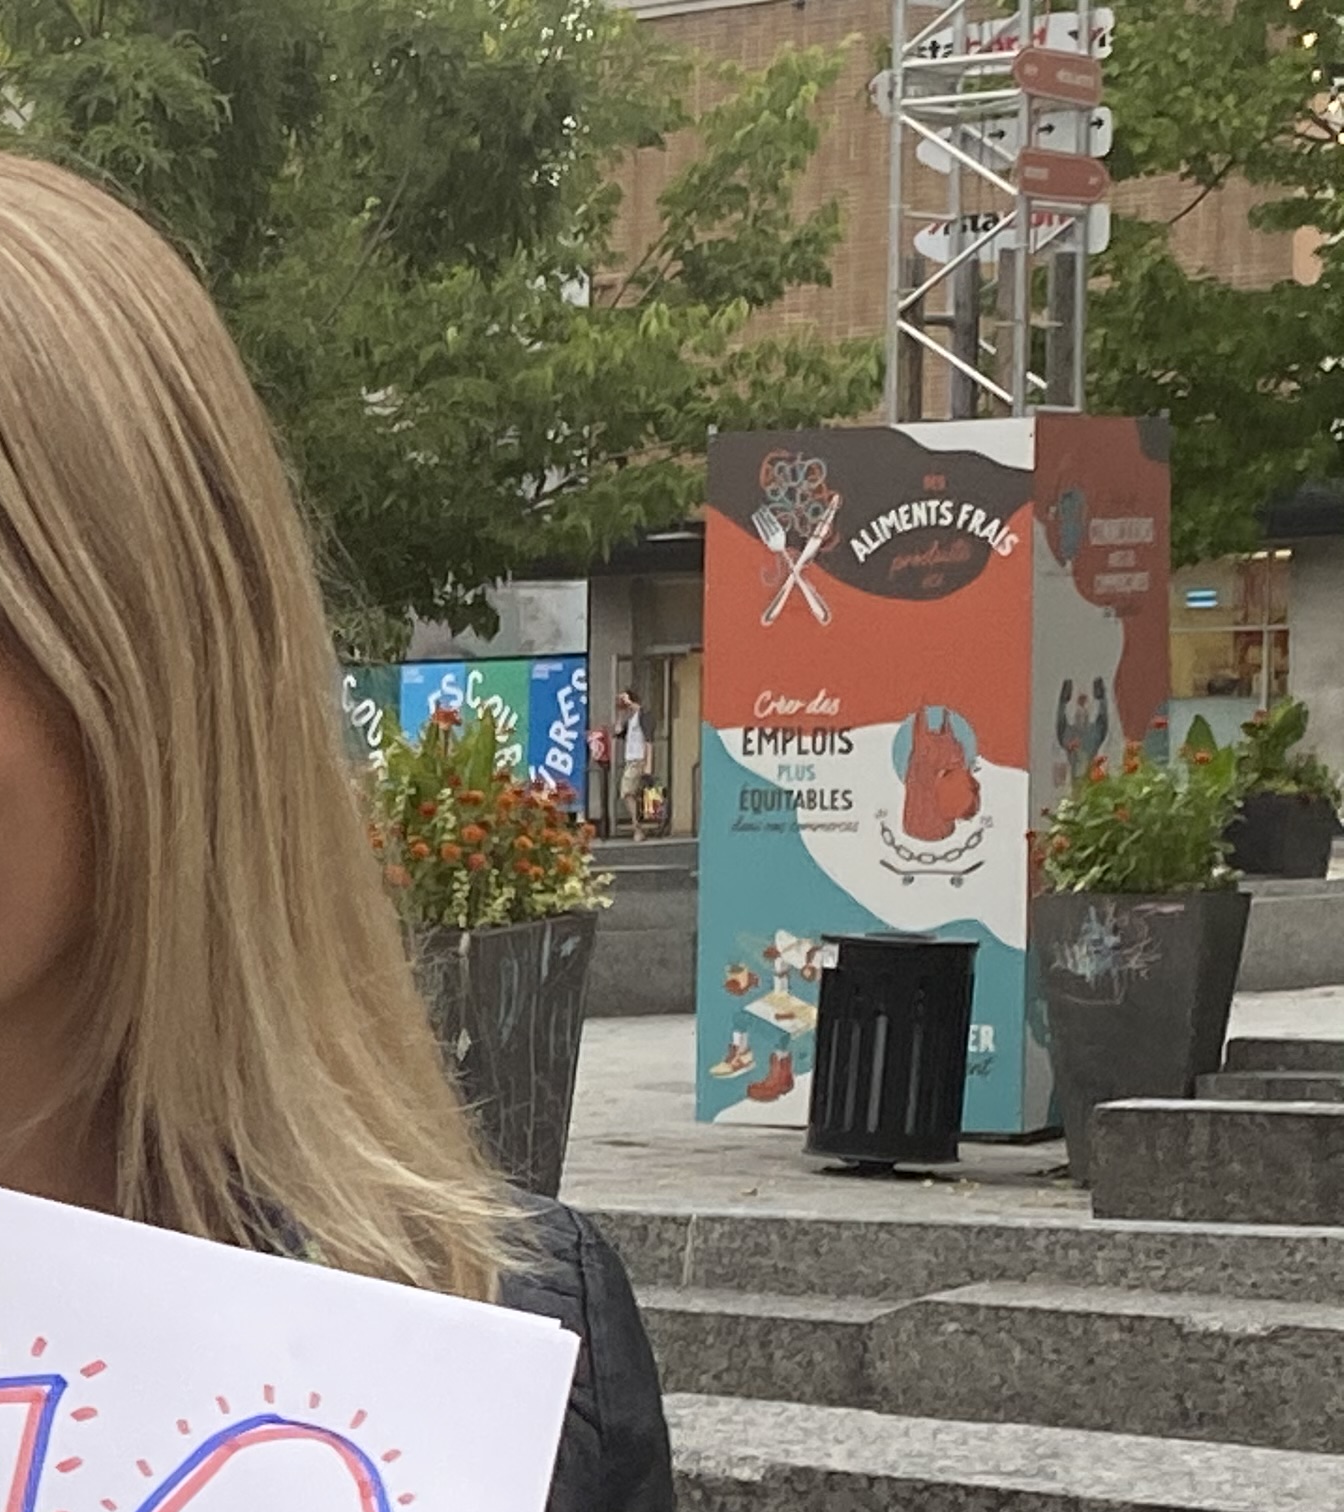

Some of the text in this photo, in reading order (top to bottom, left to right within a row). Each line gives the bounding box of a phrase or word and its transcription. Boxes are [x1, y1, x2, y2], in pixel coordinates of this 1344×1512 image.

[850, 500, 1019, 562] ALIMENTS FRAIS
[742, 726, 854, 756] EMPLOIS
[777, 765, 816, 781] PLUS
[968, 1024, 995, 1052] ER
